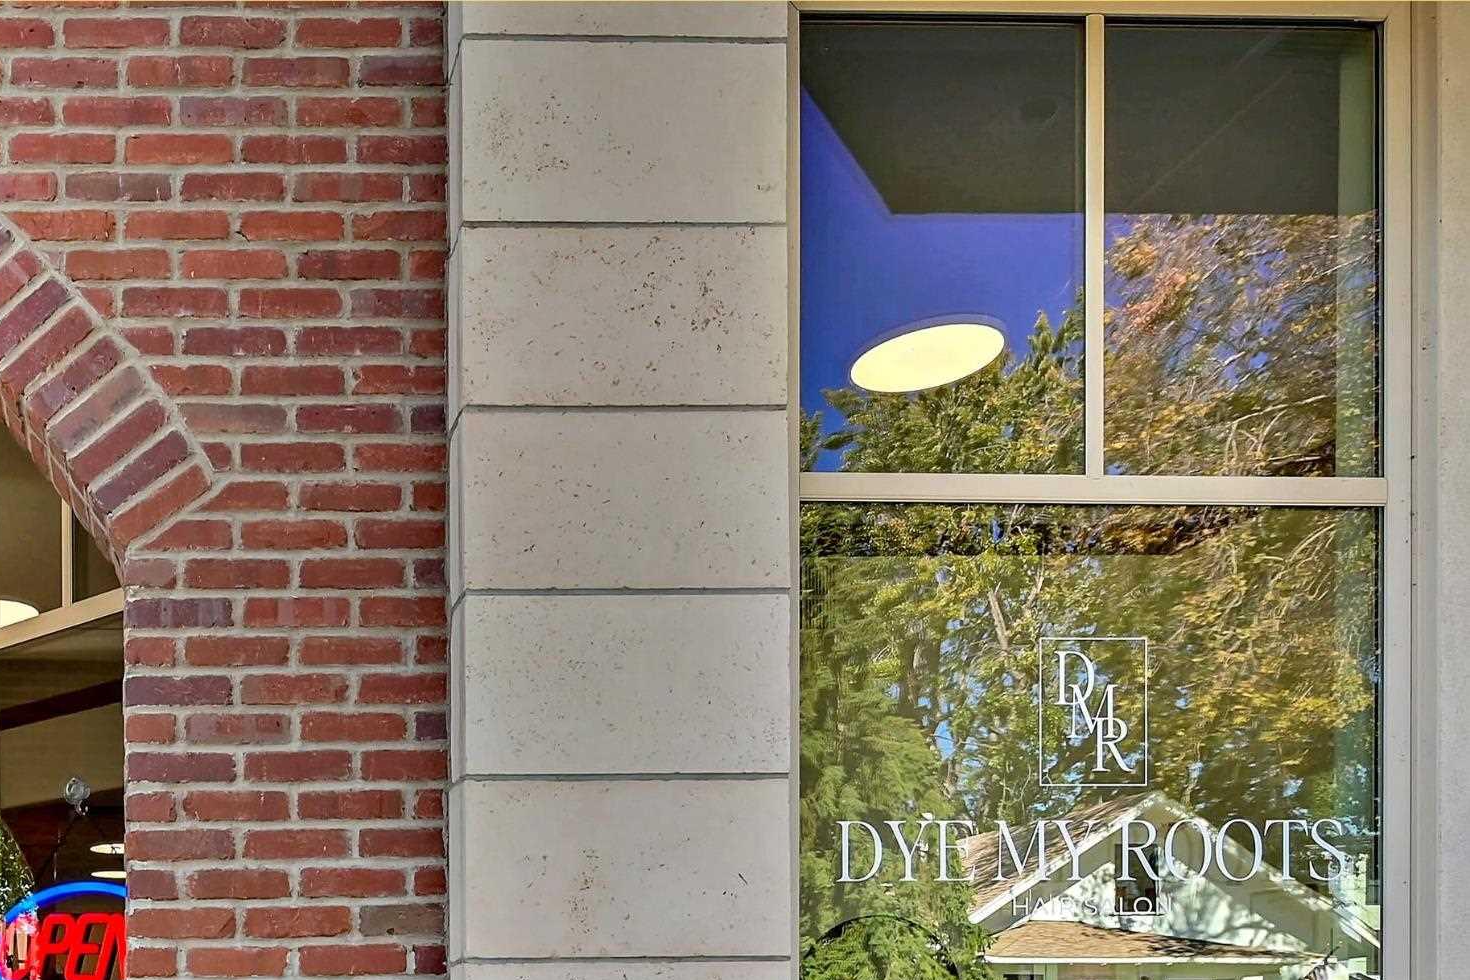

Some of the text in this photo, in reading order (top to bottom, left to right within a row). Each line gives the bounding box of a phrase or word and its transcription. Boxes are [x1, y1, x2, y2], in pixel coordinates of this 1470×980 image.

[836, 818, 1349, 883] DYE MY ROOTS
[1012, 896, 1172, 917] HAIR SALON
